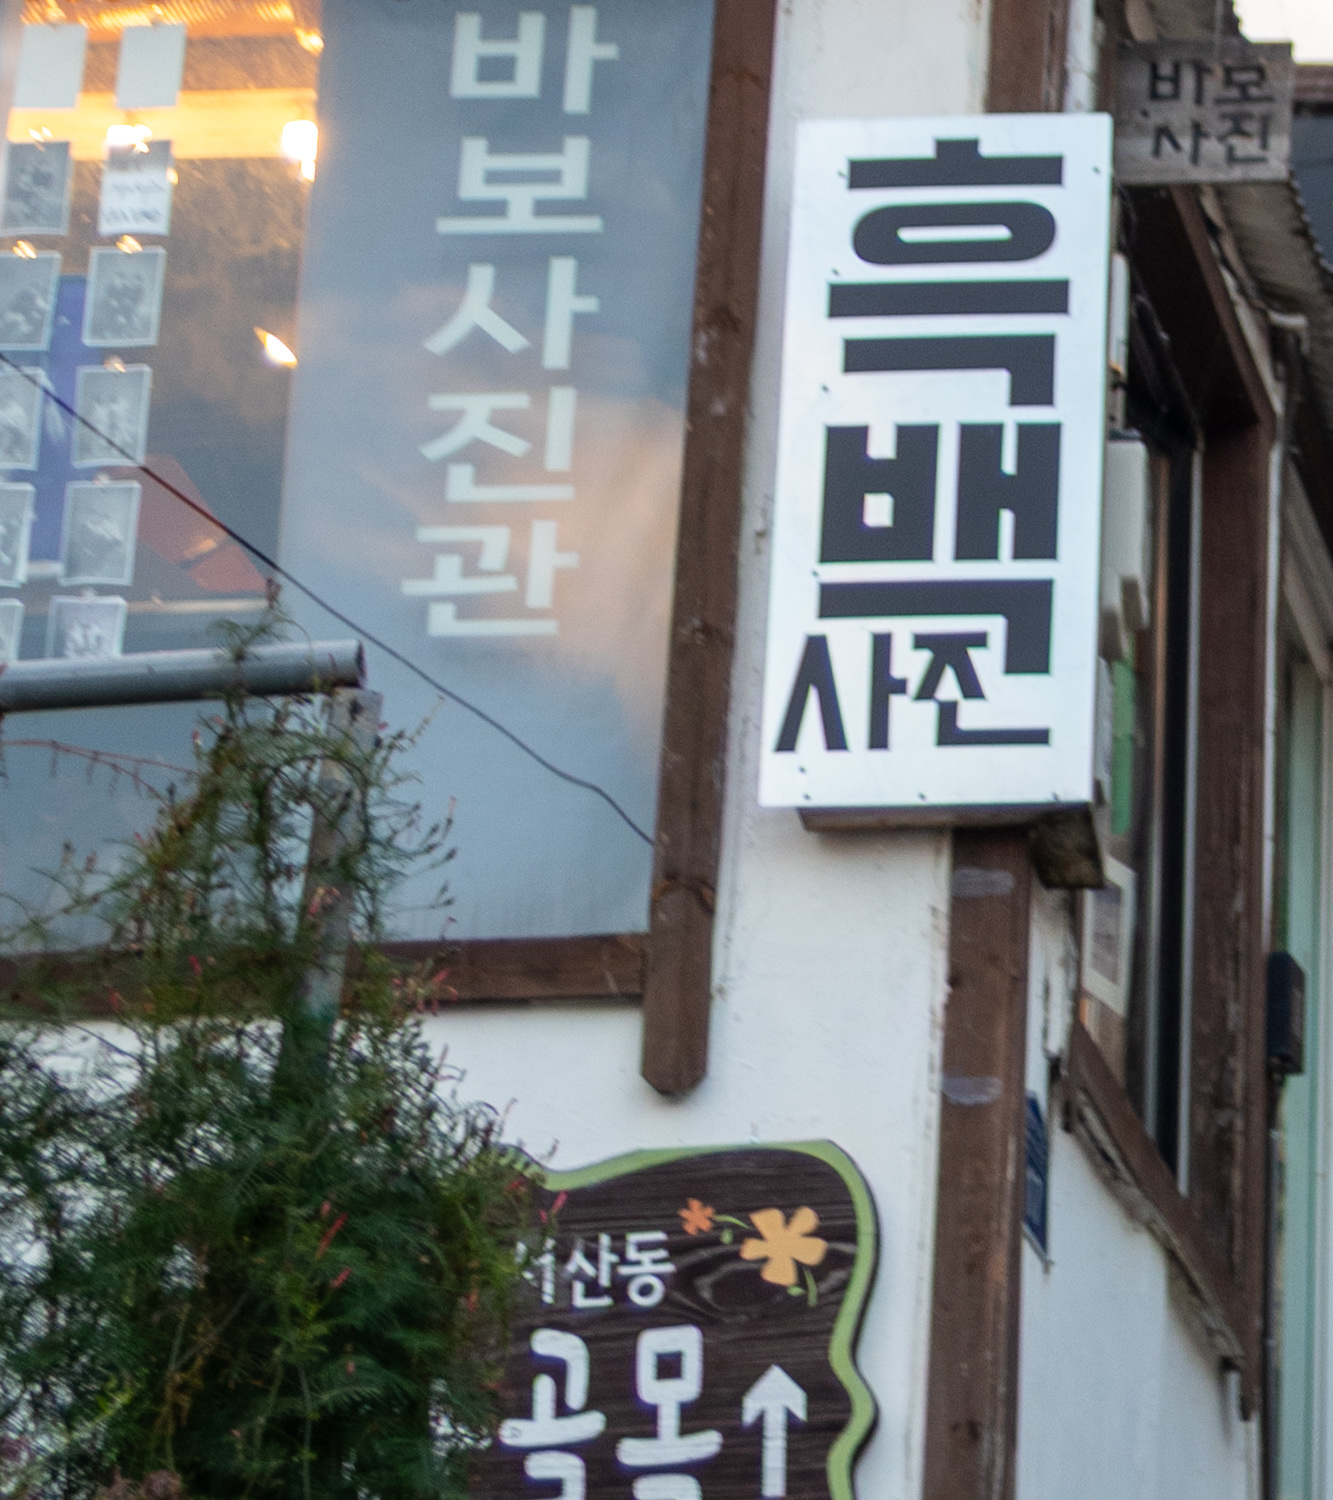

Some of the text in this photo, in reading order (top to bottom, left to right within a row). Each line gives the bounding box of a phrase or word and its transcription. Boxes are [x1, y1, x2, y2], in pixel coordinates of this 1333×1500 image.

[1151, 111, 1272, 166] 사진
[401, 4, 620, 638] 바보사진관
[817, 137, 1071, 675] 흑백
[773, 631, 1052, 752] 사진
